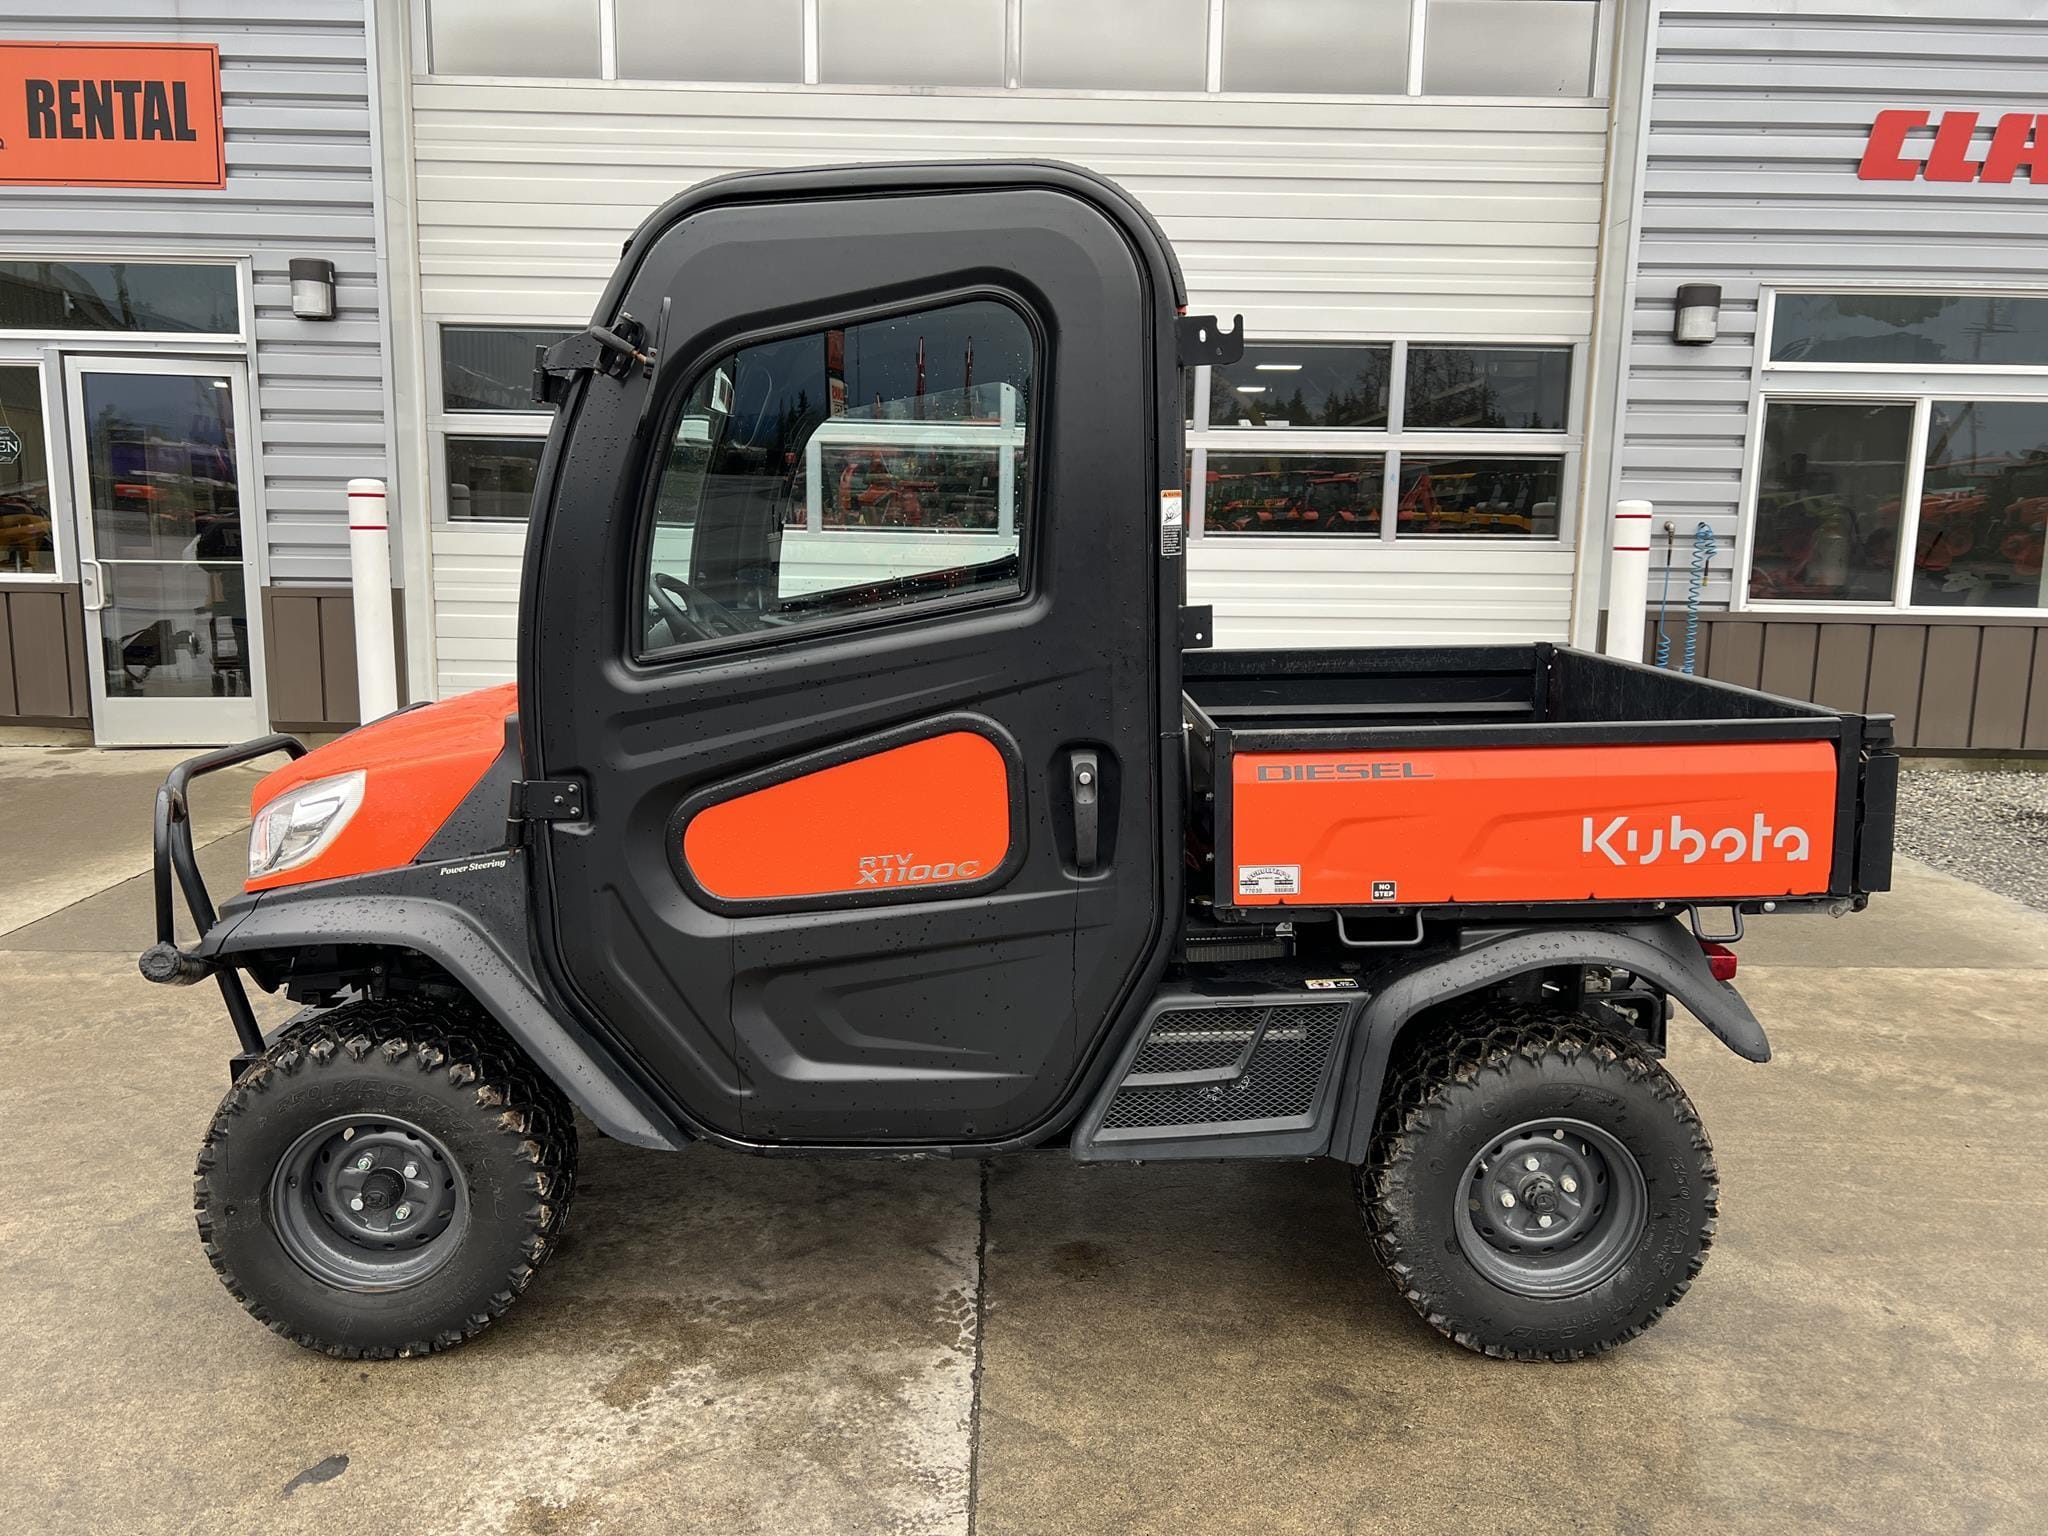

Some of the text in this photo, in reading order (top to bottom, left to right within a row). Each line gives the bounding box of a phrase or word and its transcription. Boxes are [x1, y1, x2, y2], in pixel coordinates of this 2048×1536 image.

[25, 79, 197, 141] RENTAL
[1257, 763, 1434, 781] DIESEL
[1582, 812, 1809, 866] Kubota
[440, 859, 506, 875] Power Steering
[859, 853, 913, 868] RTV
[856, 860, 980, 885] X1100C
